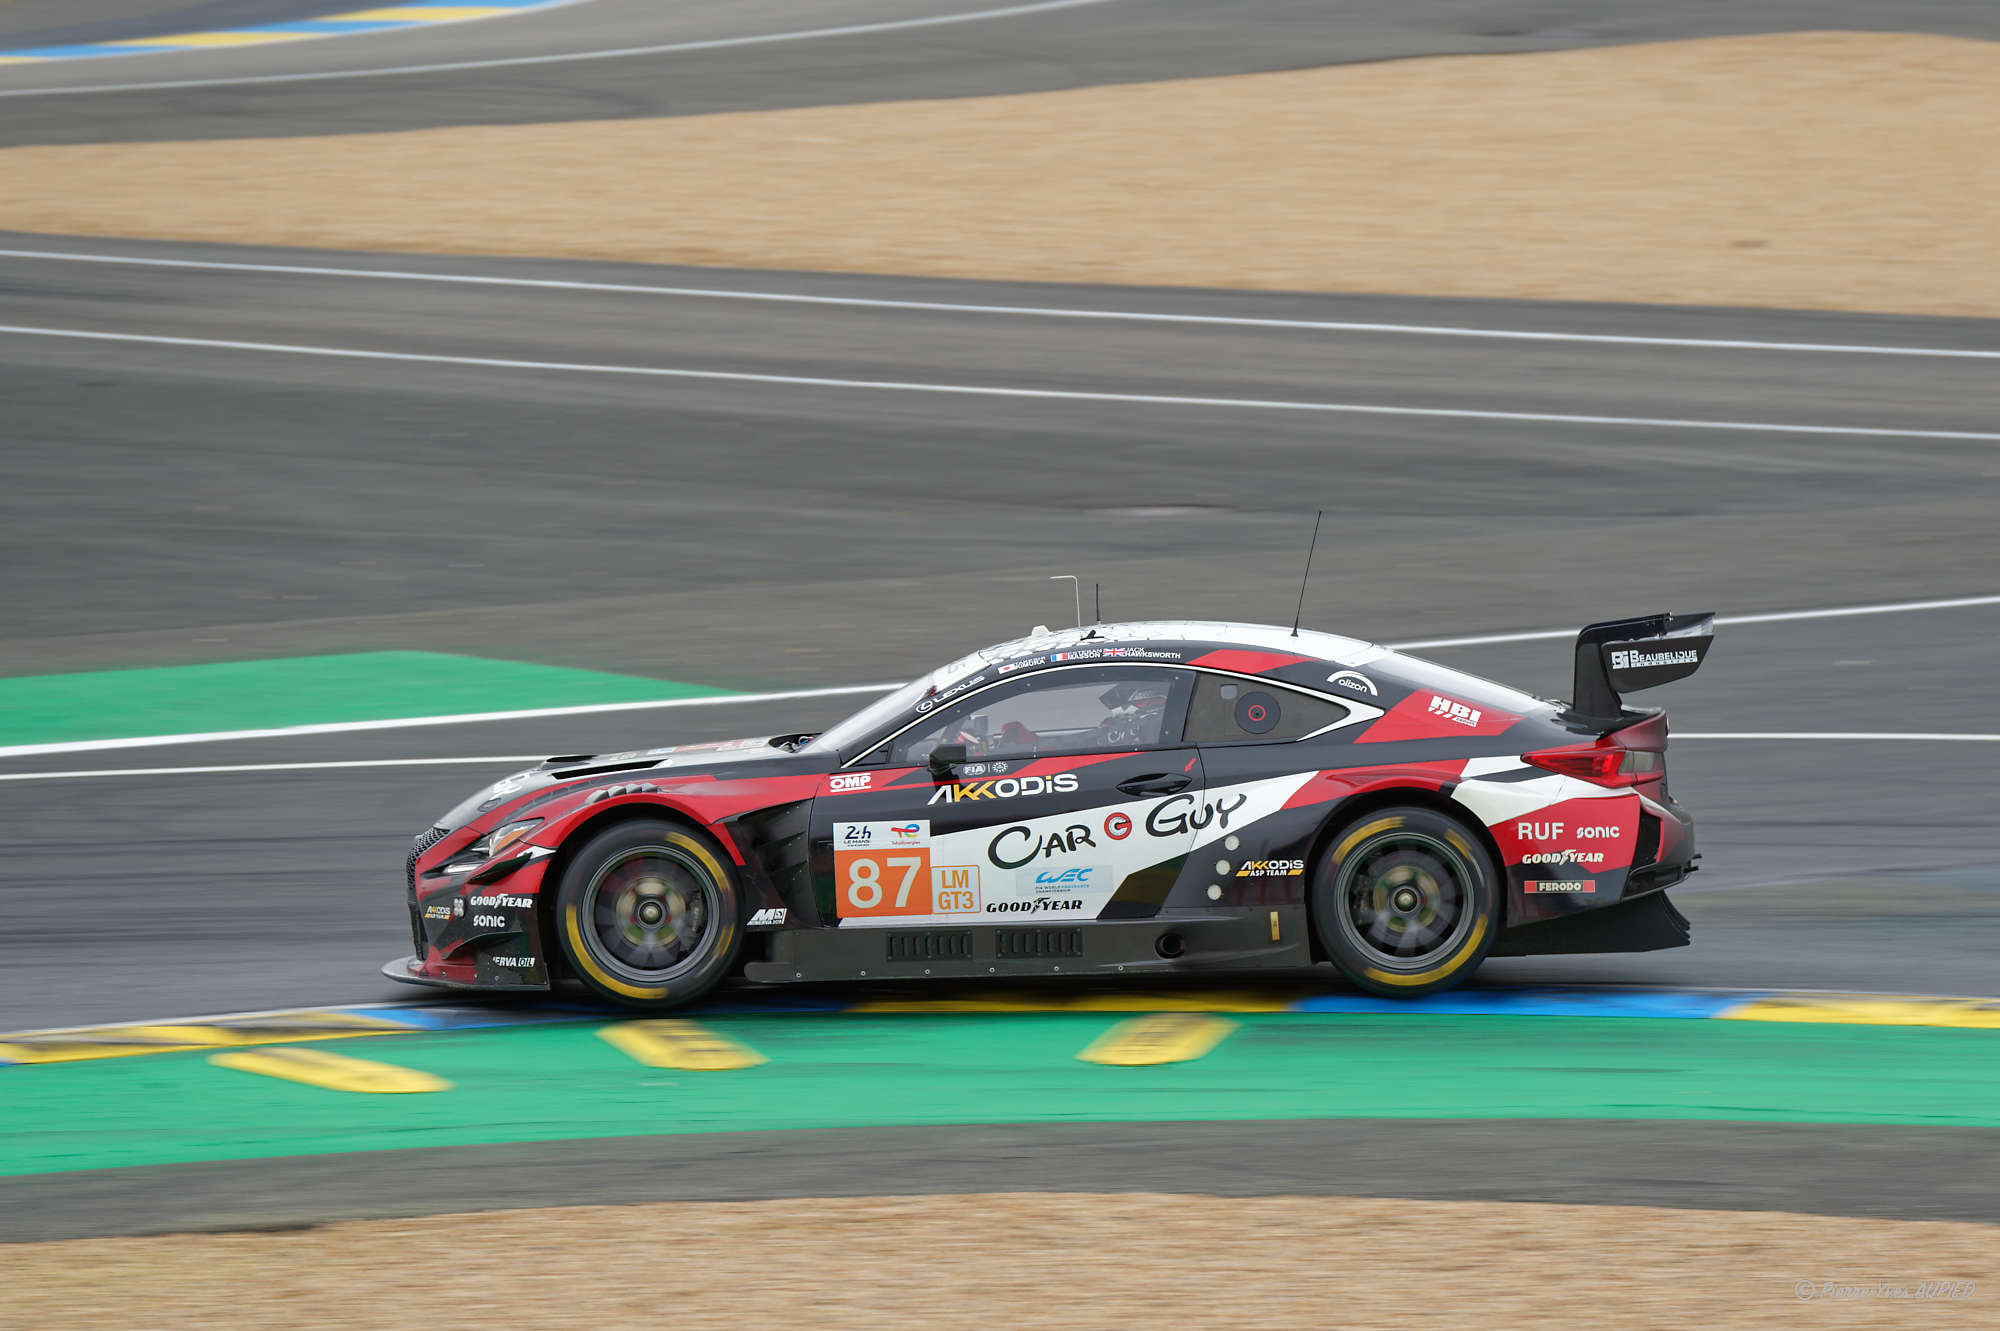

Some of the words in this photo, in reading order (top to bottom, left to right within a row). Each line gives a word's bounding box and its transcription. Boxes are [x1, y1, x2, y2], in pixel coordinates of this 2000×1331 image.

[1125, 651, 1181, 659] HAWKSWORTH
[934, 675, 985, 702] LEXUS
[1338, 678, 1368, 693] alizon
[1429, 695, 1482, 722] HBI
[830, 775, 871, 788] OMP
[987, 824, 1097, 870] CAR
[1145, 793, 1248, 837] GUY
[1518, 822, 1565, 840] RUF
[1522, 849, 1604, 866] GOODYEAR
[941, 870, 969, 889] LM
[1035, 868, 1093, 884] WEC
[1249, 869, 1265, 877] ASP
[847, 856, 922, 909] 87
[1538, 881, 1582, 892] FERODO
[470, 893, 533, 908] GOODYEAR
[938, 891, 974, 910] GT3
[986, 897, 1083, 914] GOODYEAR
